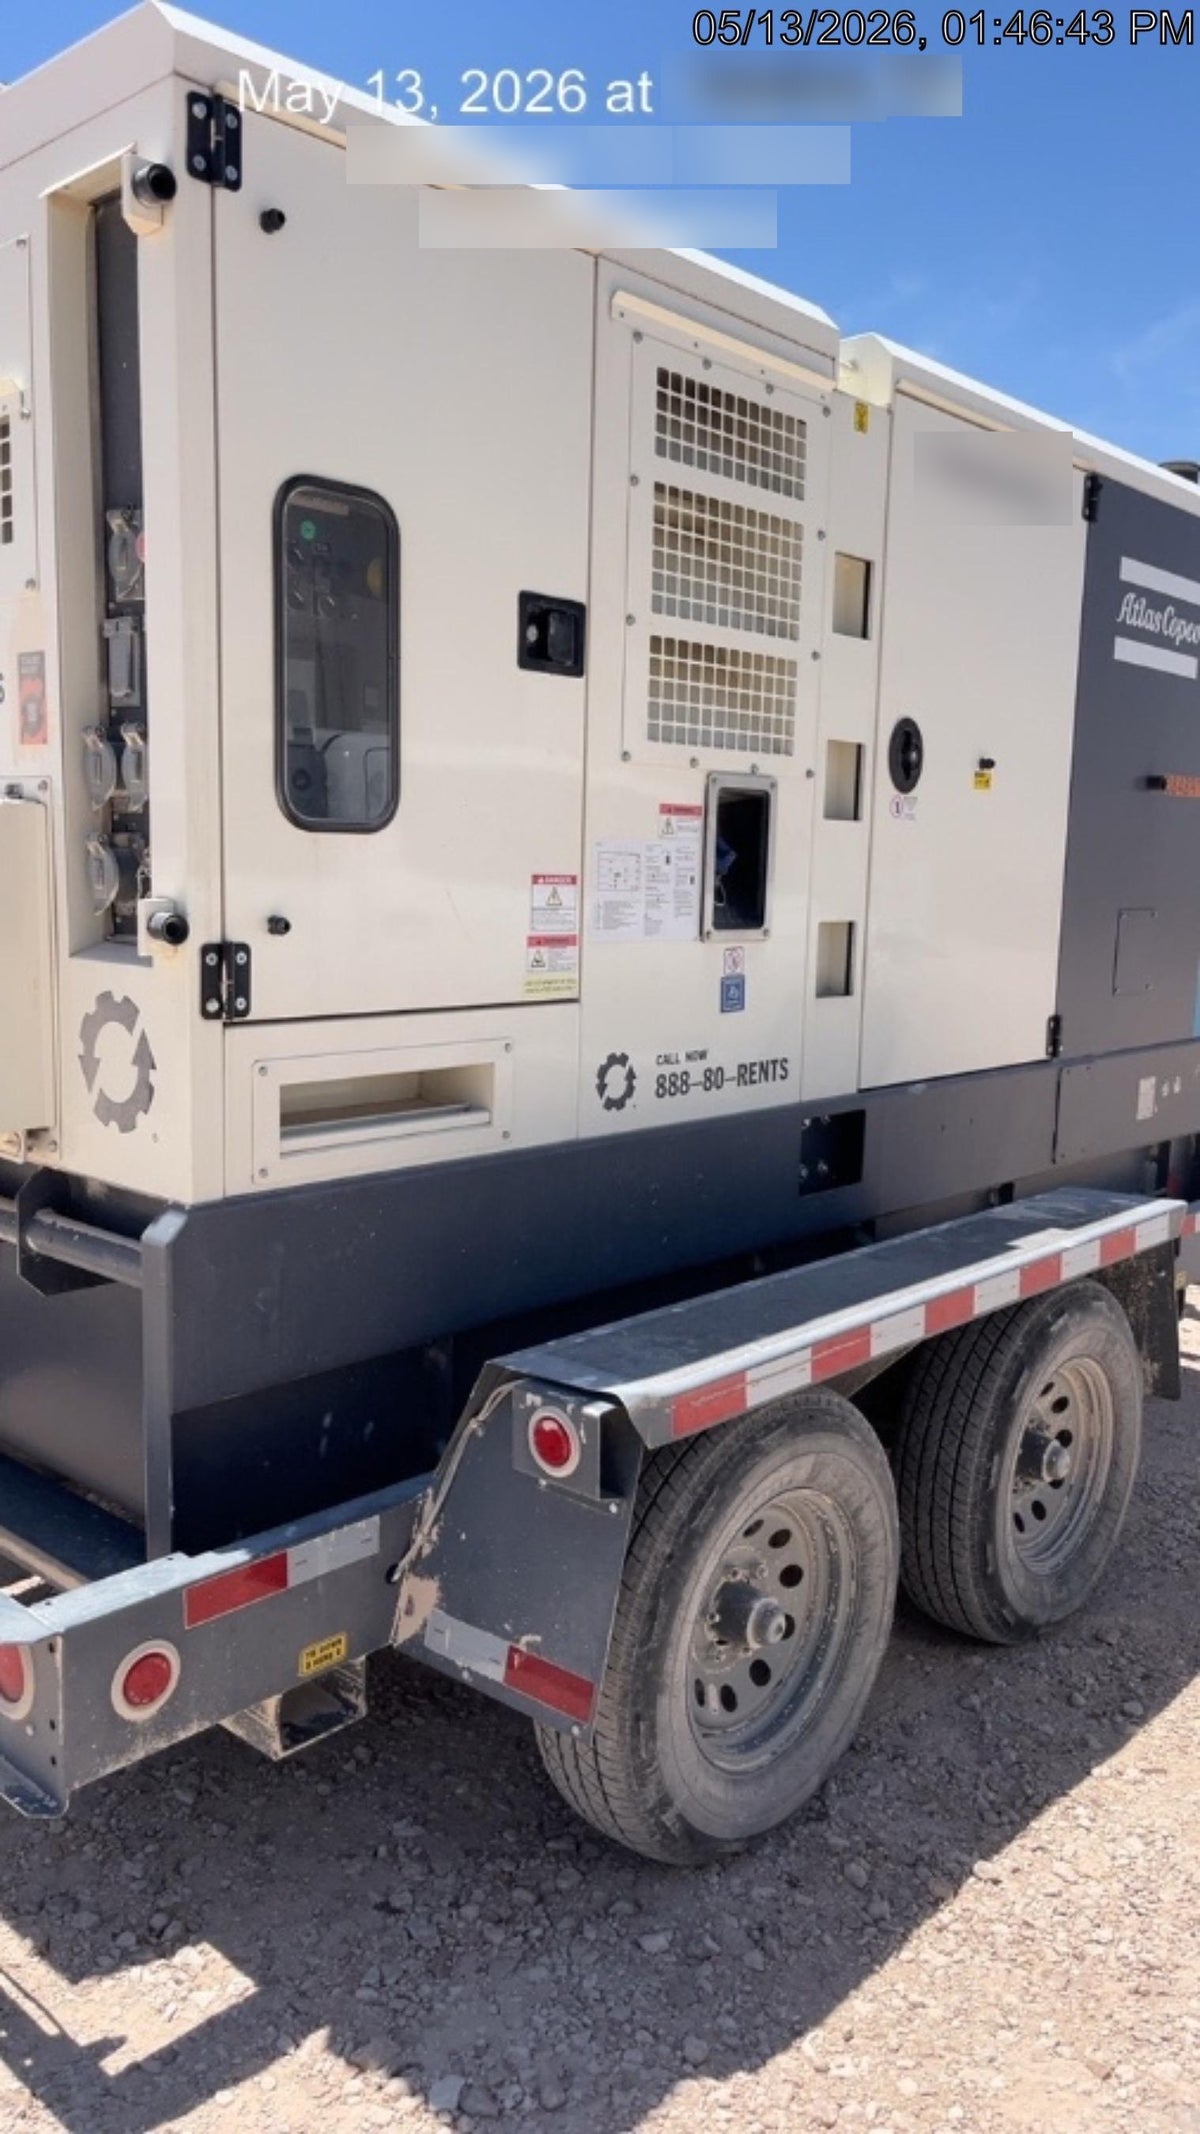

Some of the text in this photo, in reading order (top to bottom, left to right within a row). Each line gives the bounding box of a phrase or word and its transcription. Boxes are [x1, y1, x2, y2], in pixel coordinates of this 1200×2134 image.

[1116, 592, 1162, 633] Atlas
[655, 1057, 788, 1099] 888-80-RENTS
[656, 1050, 708, 1066] CALL NOW
